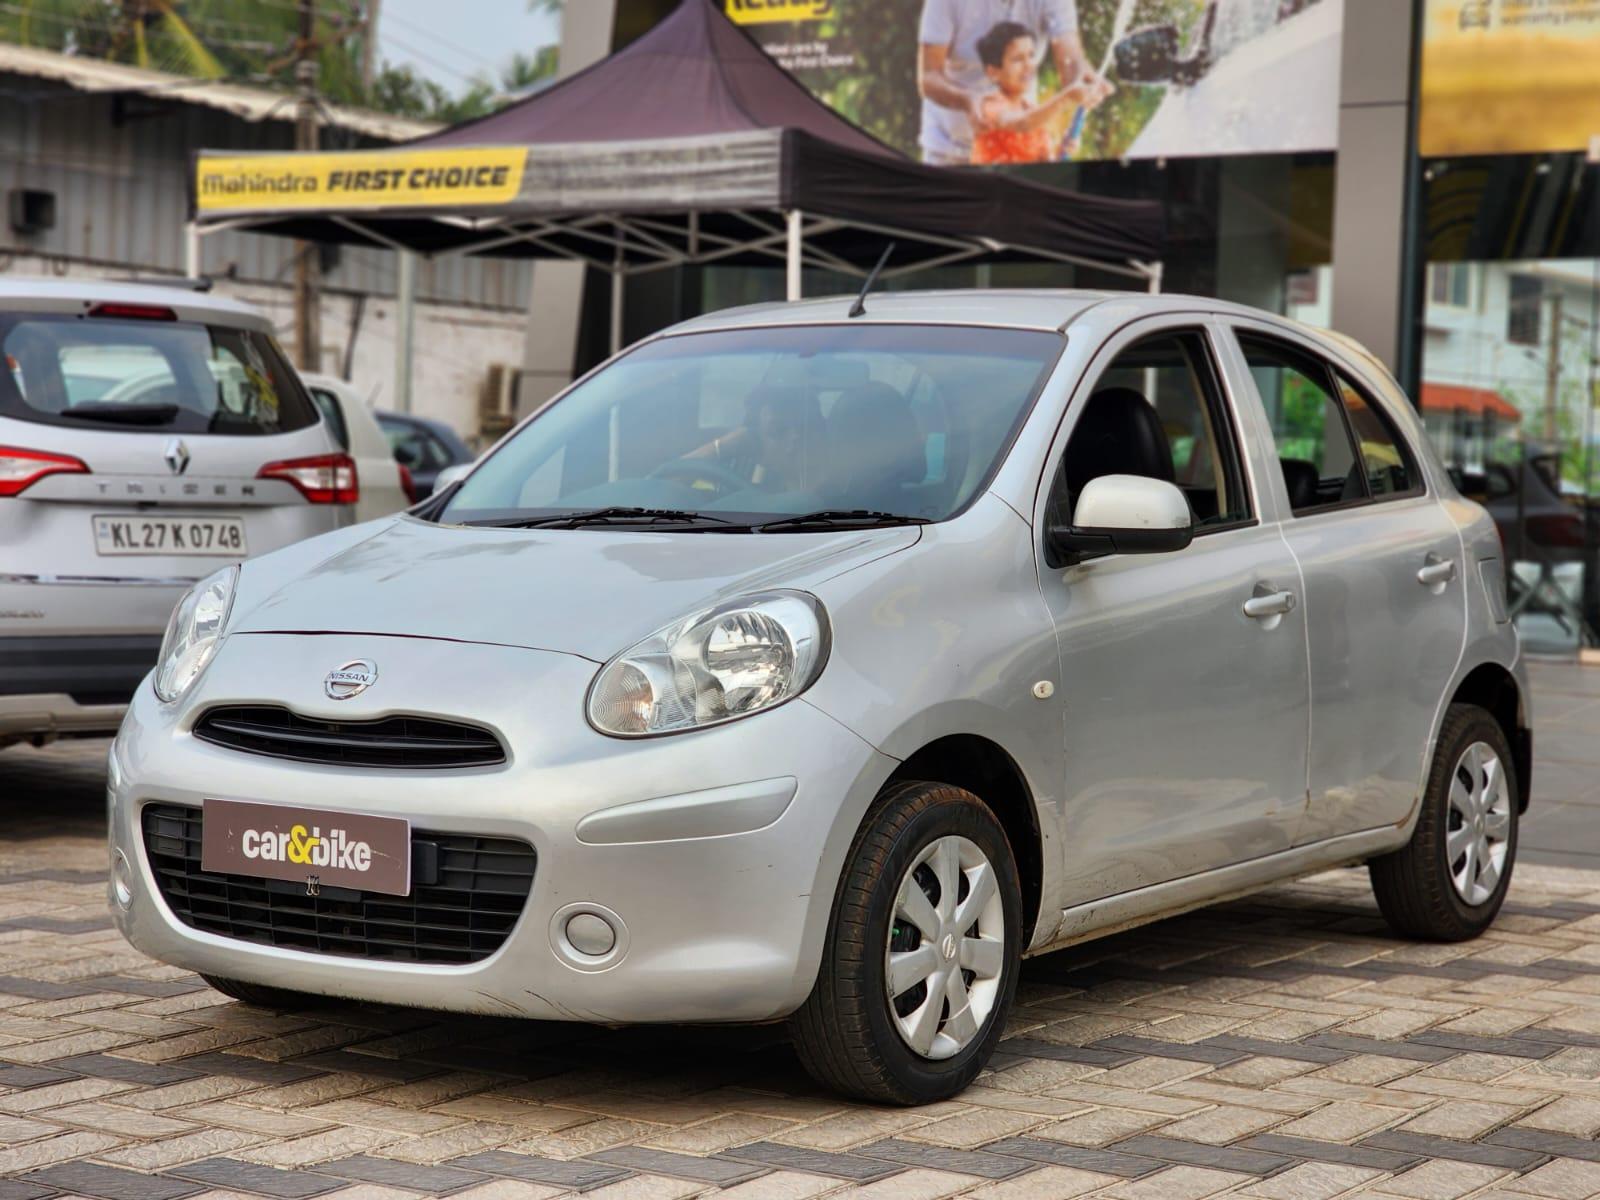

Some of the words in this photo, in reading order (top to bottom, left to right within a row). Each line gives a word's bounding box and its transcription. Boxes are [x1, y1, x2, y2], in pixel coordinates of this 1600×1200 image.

[202, 173, 318, 195] Mahindra
[327, 169, 405, 192] FIRST
[407, 166, 510, 190] CHOICE
[190, 524, 242, 549] 0748
[329, 672, 369, 682] NISSAN
[242, 824, 372, 872] car&bike
